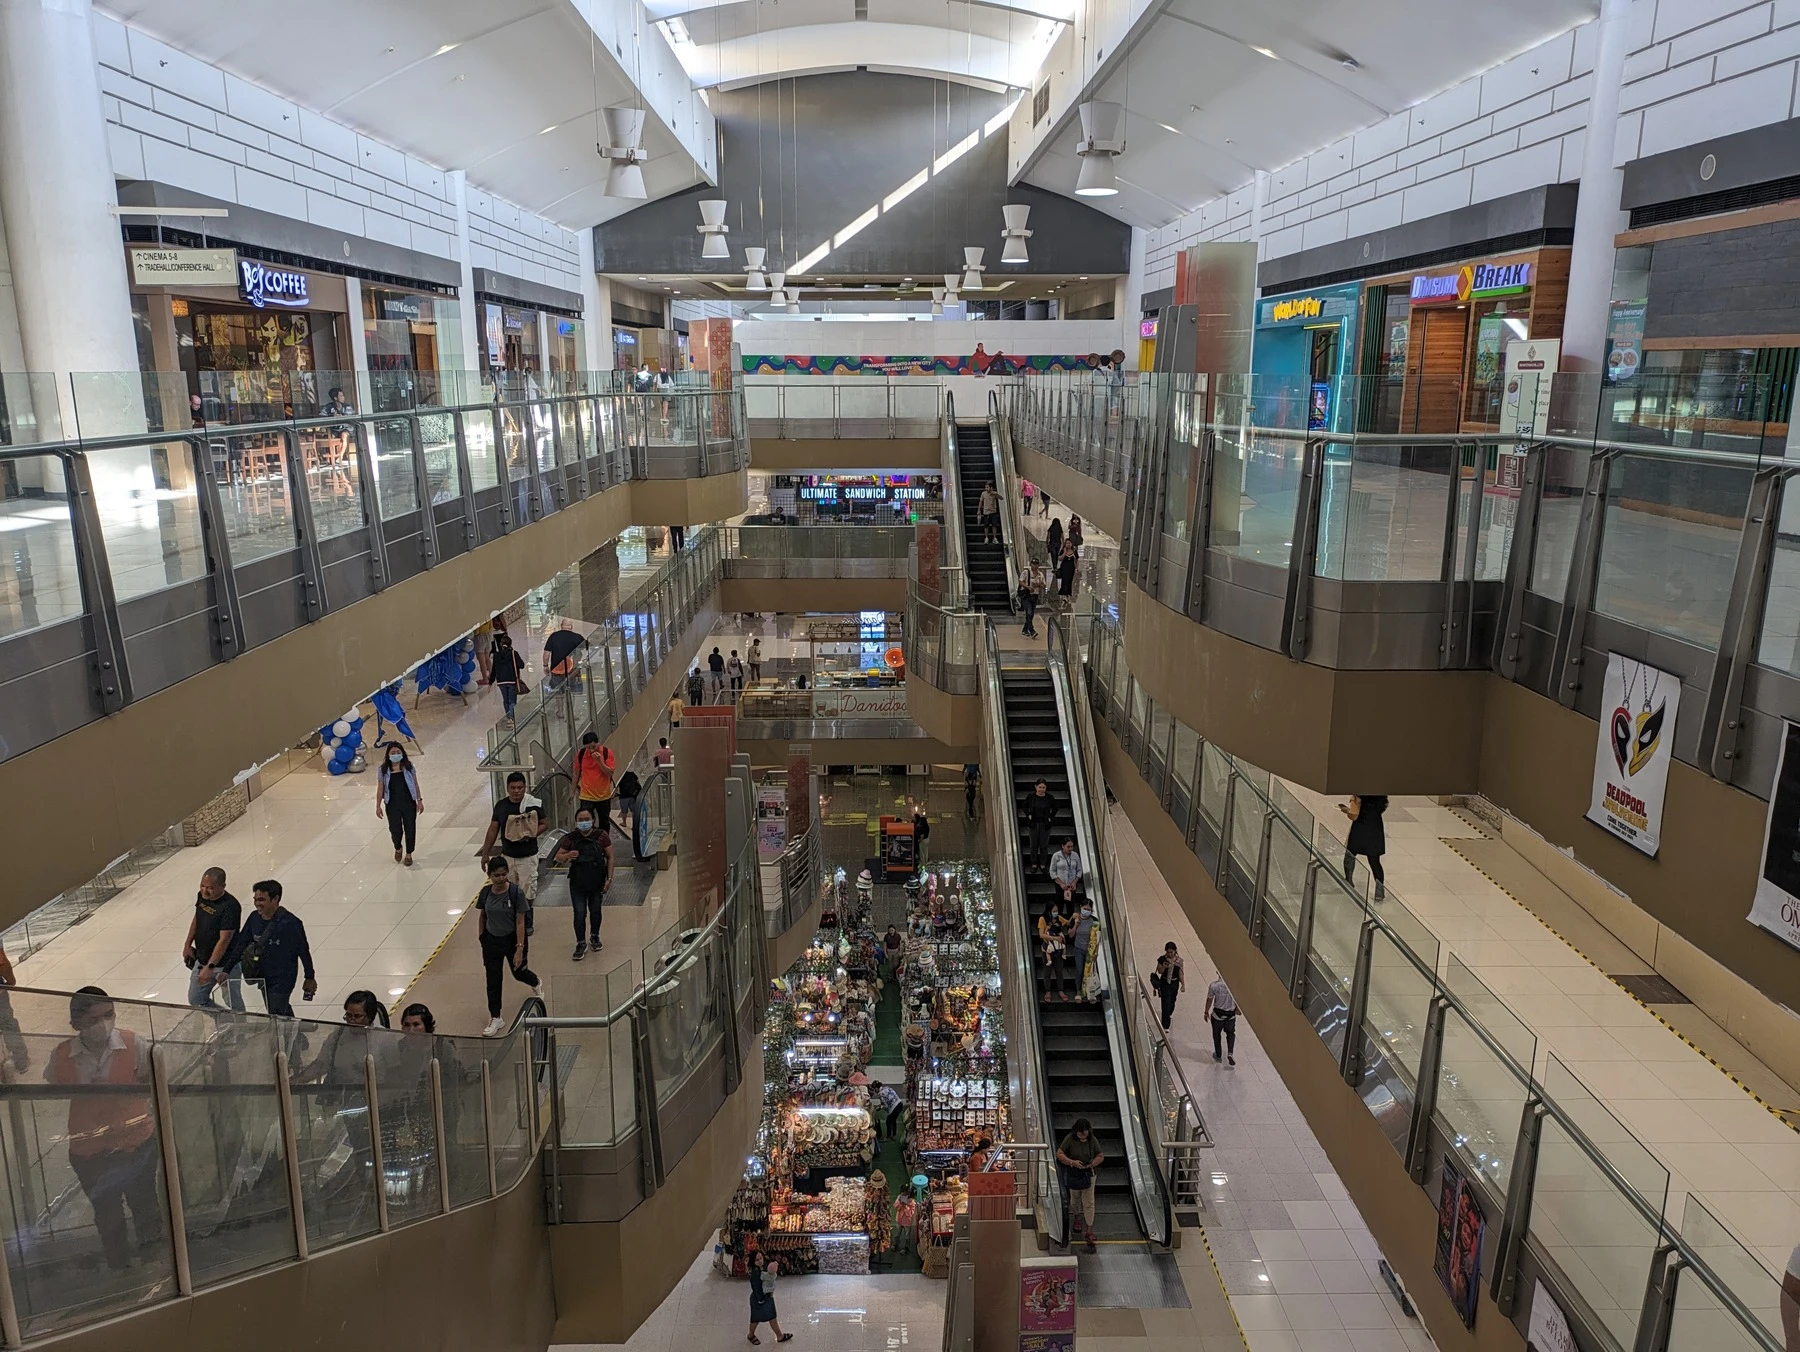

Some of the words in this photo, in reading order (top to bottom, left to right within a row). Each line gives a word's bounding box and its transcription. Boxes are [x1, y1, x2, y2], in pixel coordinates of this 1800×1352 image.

[142, 252, 168, 261] CINEMA
[168, 252, 178, 261] 5-8
[202, 263, 216, 272] HALL
[264, 271, 307, 296] COFFEE
[1472, 263, 1525, 290] BREAK
[1273, 299, 1298, 322] WORLD
[1304, 296, 1321, 318] FUN
[801, 488, 838, 499] ULTIMATE
[845, 488, 886, 499] SANDWICH
[894, 488, 925, 499] STATION
[1606, 781, 1648, 818] DEADPOOL
[1604, 796, 1649, 832] WOLVERINE
